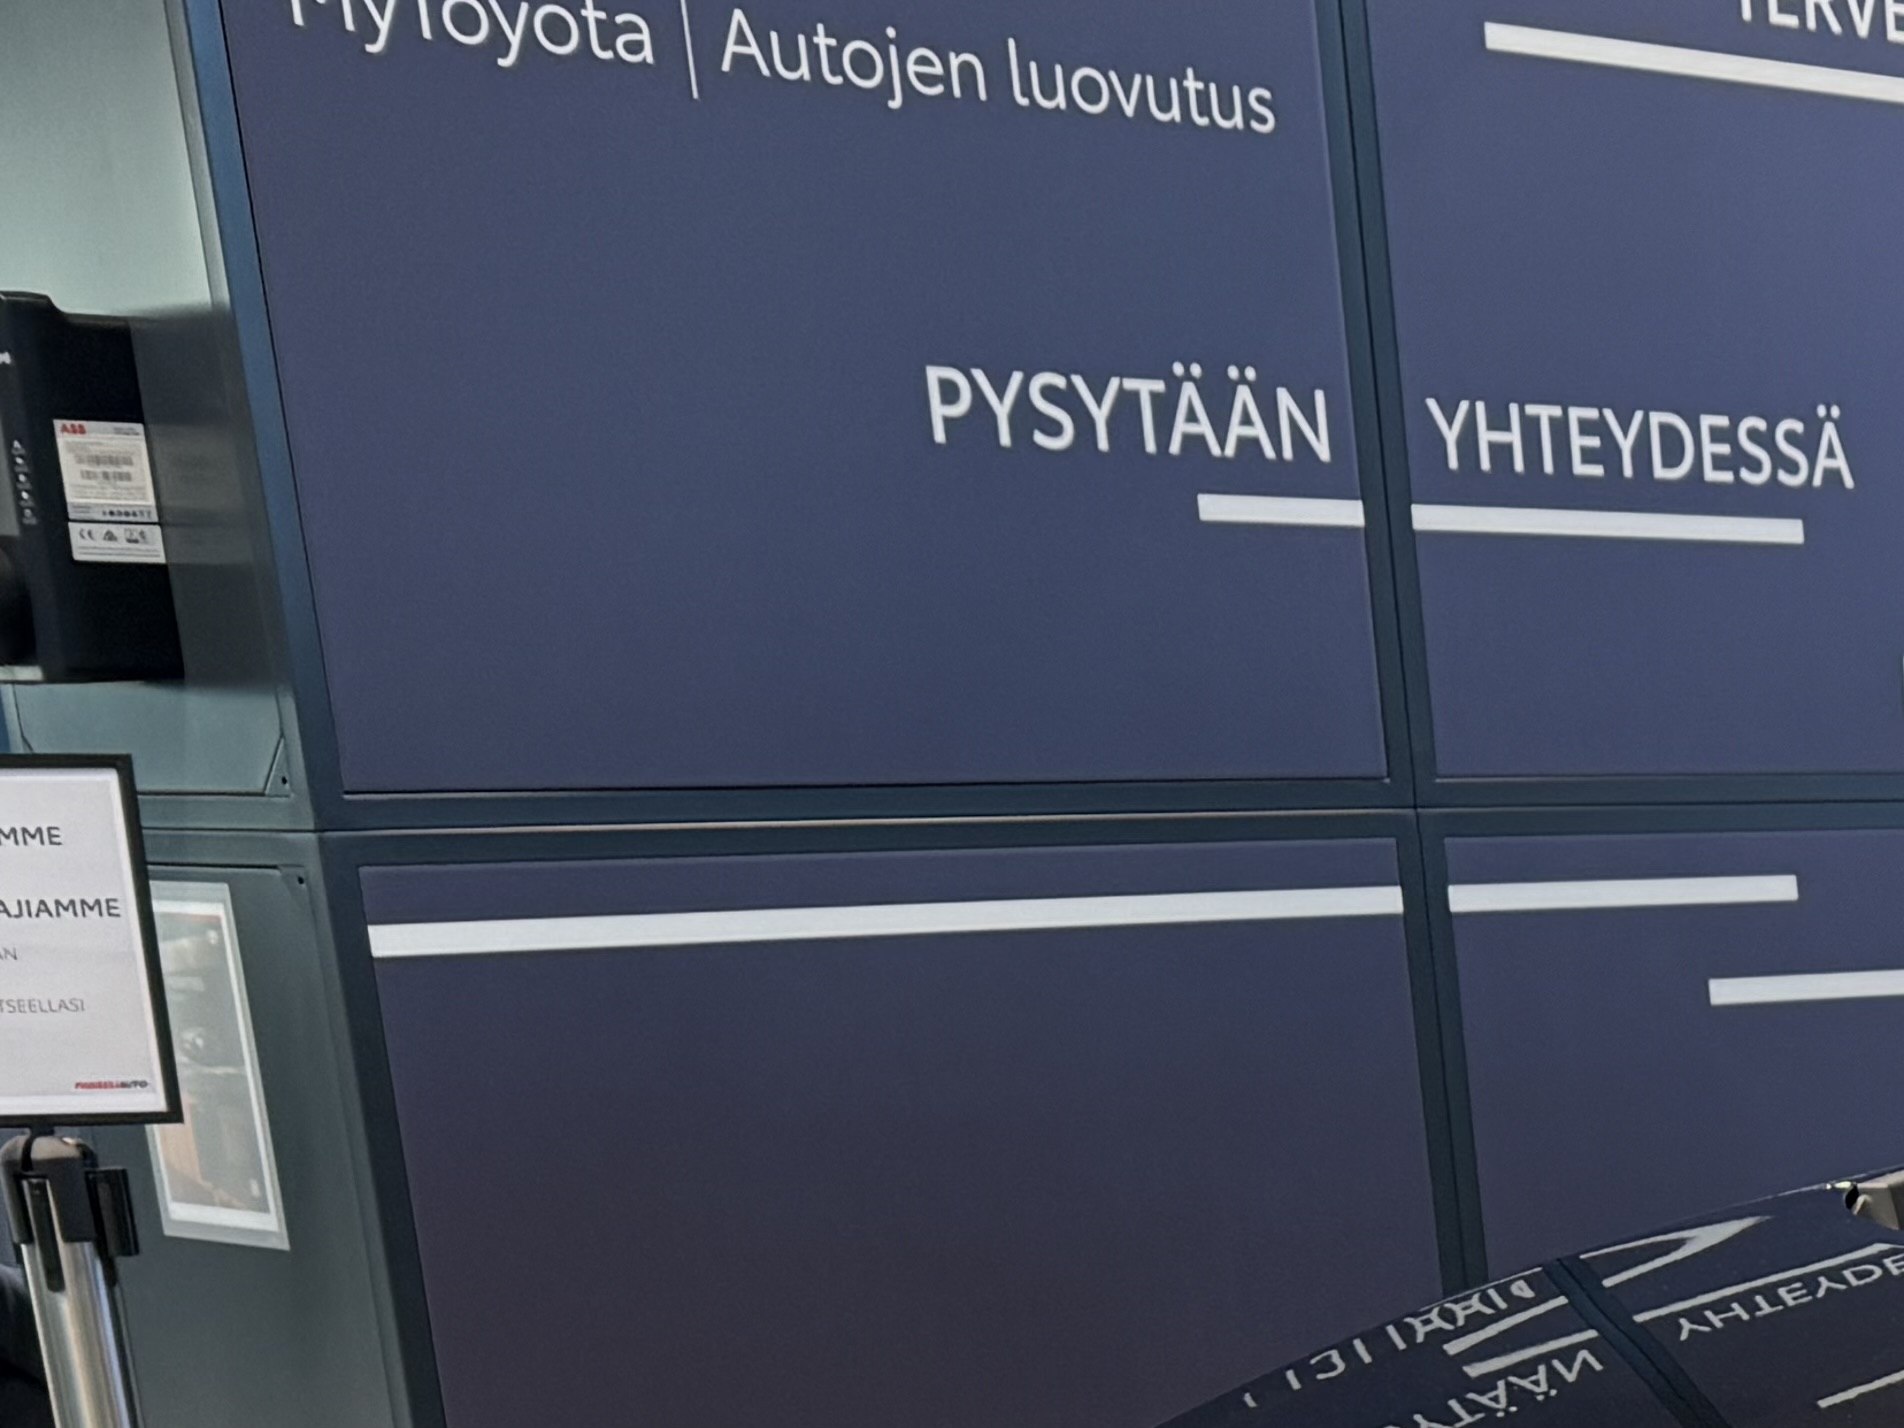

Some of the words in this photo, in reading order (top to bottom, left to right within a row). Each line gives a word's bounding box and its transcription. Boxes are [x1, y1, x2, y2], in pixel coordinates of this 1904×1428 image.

[720, 7, 988, 109] Autojen
[1006, 36, 1277, 134] luovutus
[60, 423, 87, 435] ABB
[924, 362, 1333, 464] PYSYTÄÄN
[1424, 397, 1856, 491] YHTEYDESSÄ
